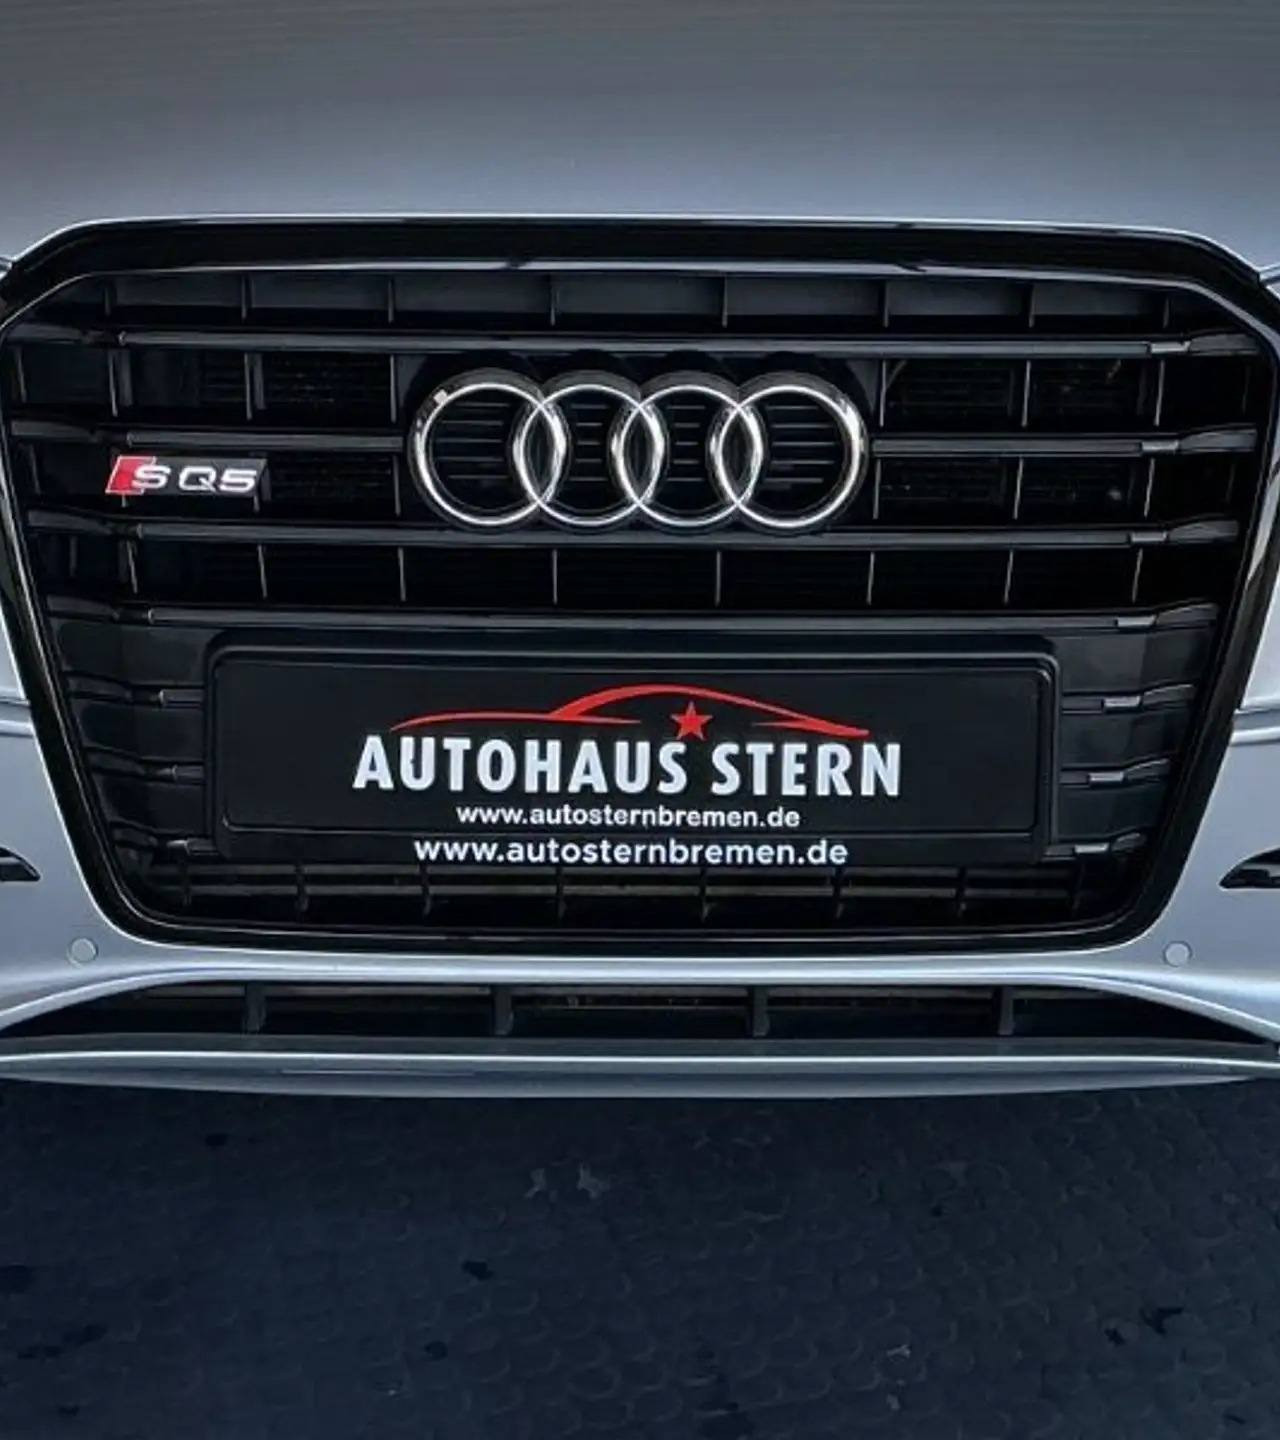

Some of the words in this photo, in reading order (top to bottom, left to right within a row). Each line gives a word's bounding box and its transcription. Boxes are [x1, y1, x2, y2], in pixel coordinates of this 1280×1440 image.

[352, 734, 688, 795] AUTOHAUS
[710, 741, 902, 798] STERN
[455, 803, 801, 829] www.autosternbremen.de
[413, 837, 849, 866] www.autosternbremen.de
